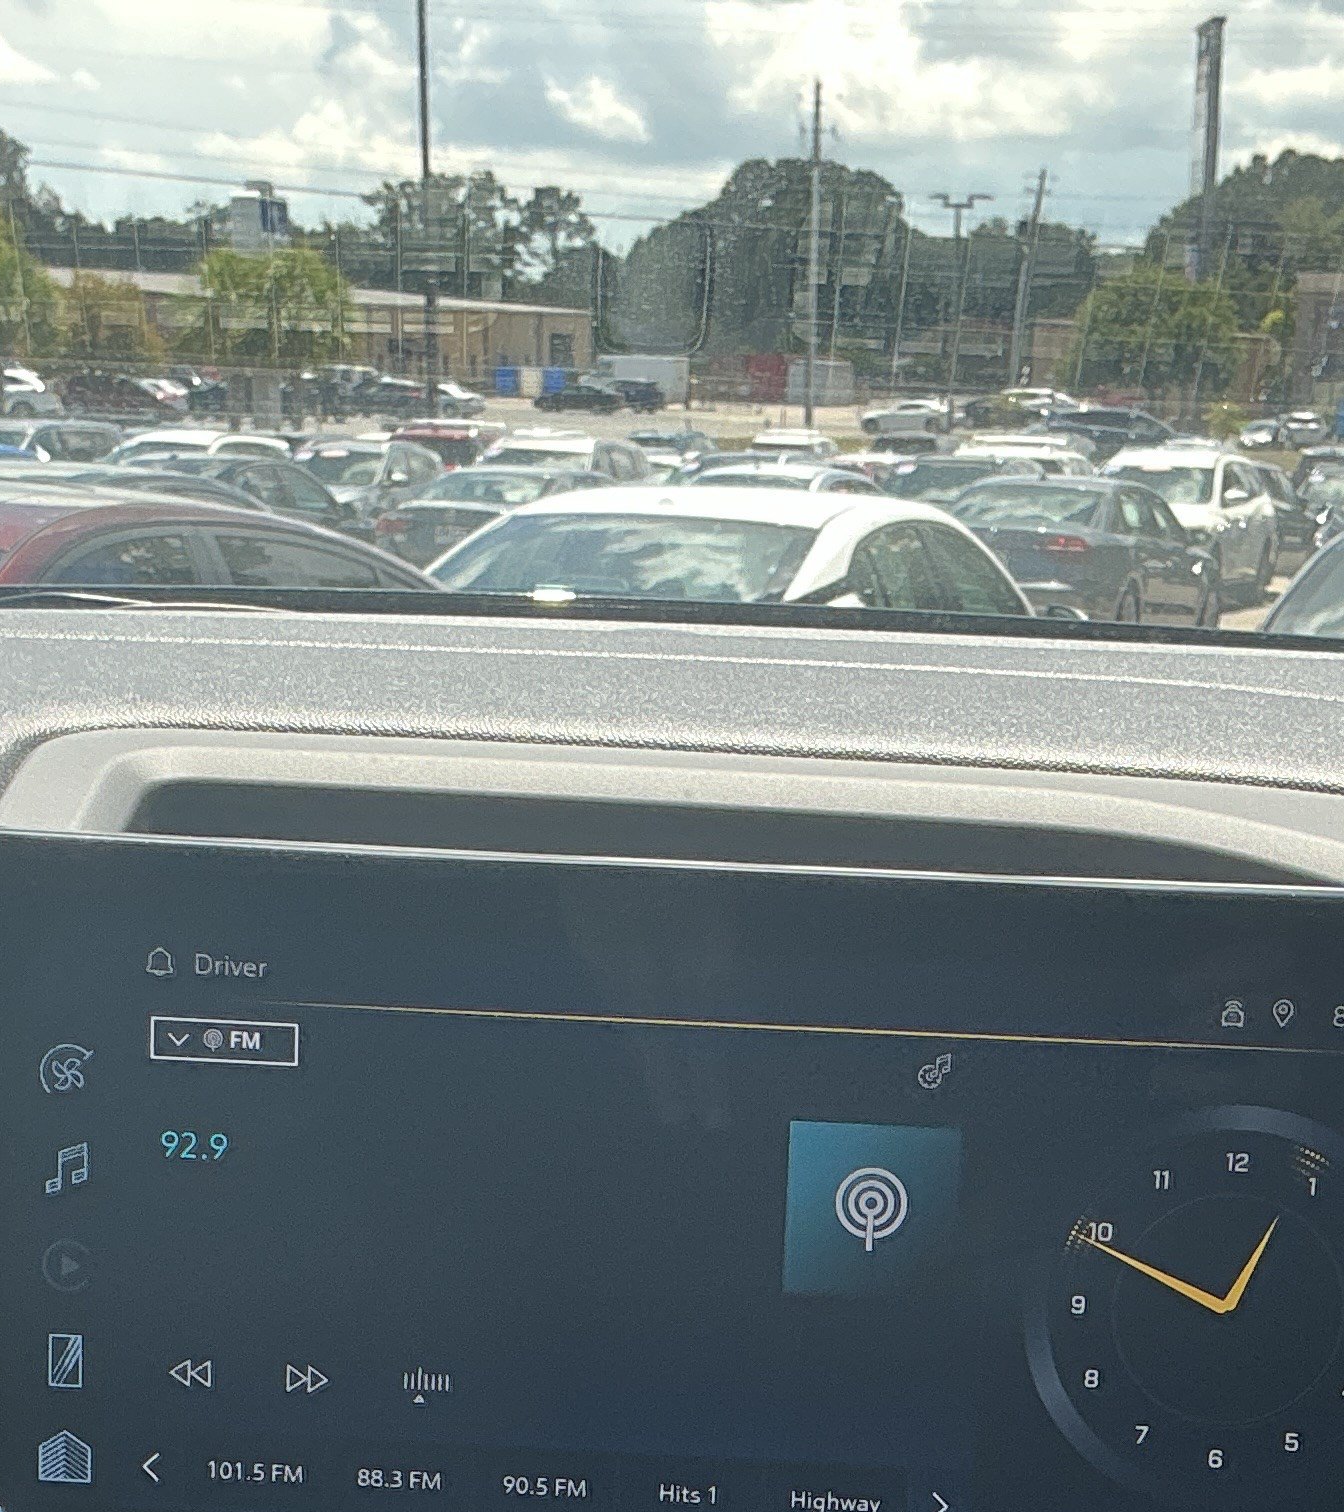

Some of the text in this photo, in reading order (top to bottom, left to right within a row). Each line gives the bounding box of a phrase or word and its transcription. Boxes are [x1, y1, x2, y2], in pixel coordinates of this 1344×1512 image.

[194, 953, 267, 978] Driver
[230, 1030, 261, 1050] FM
[160, 1130, 228, 1160] 92.9
[1226, 1152, 1249, 1173] 12
[1153, 1170, 1170, 1190] 11
[1307, 1177, 1319, 1197] 1
[1071, 1295, 1086, 1315] 9
[1084, 1369, 1099, 1388] 8
[1135, 1425, 1149, 1444] 7
[1284, 1432, 1299, 1452] 5
[1208, 1449, 1223, 1469] 6
[208, 1460, 303, 1483] 101.5 FM
[357, 1468, 441, 1490] 88.3 FM
[503, 1475, 587, 1497] 90.5 FM
[659, 1484, 718, 1504] Hits 1
